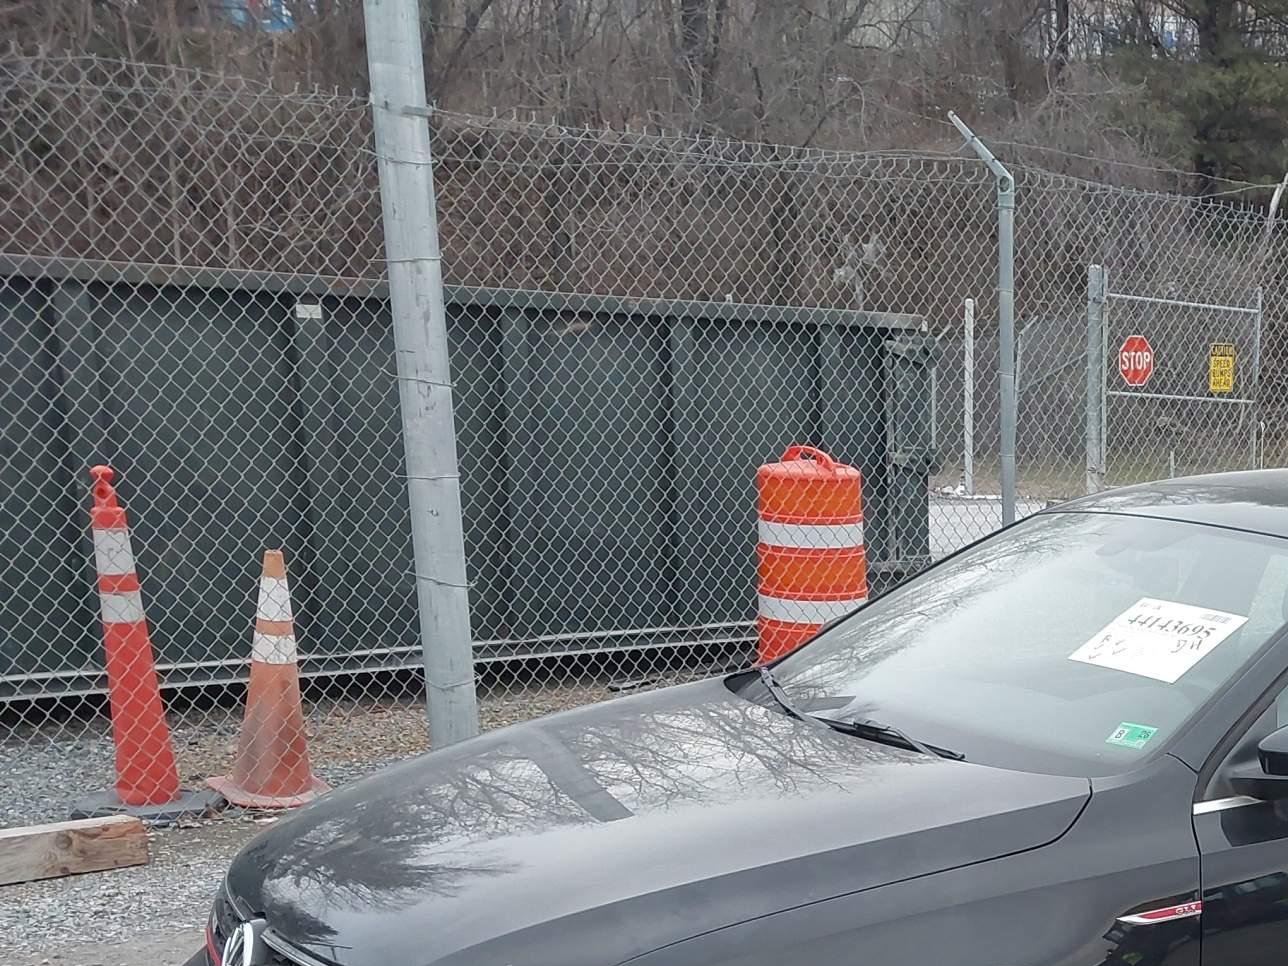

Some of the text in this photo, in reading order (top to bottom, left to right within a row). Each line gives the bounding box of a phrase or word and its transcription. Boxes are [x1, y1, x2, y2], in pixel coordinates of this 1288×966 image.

[1121, 351, 1151, 371] STOP
[1213, 358, 1231, 368] SPEED
[1212, 368, 1232, 378] BUMPS
[1212, 378, 1231, 388] AHEAD
[1128, 614, 1217, 640] 44143695
